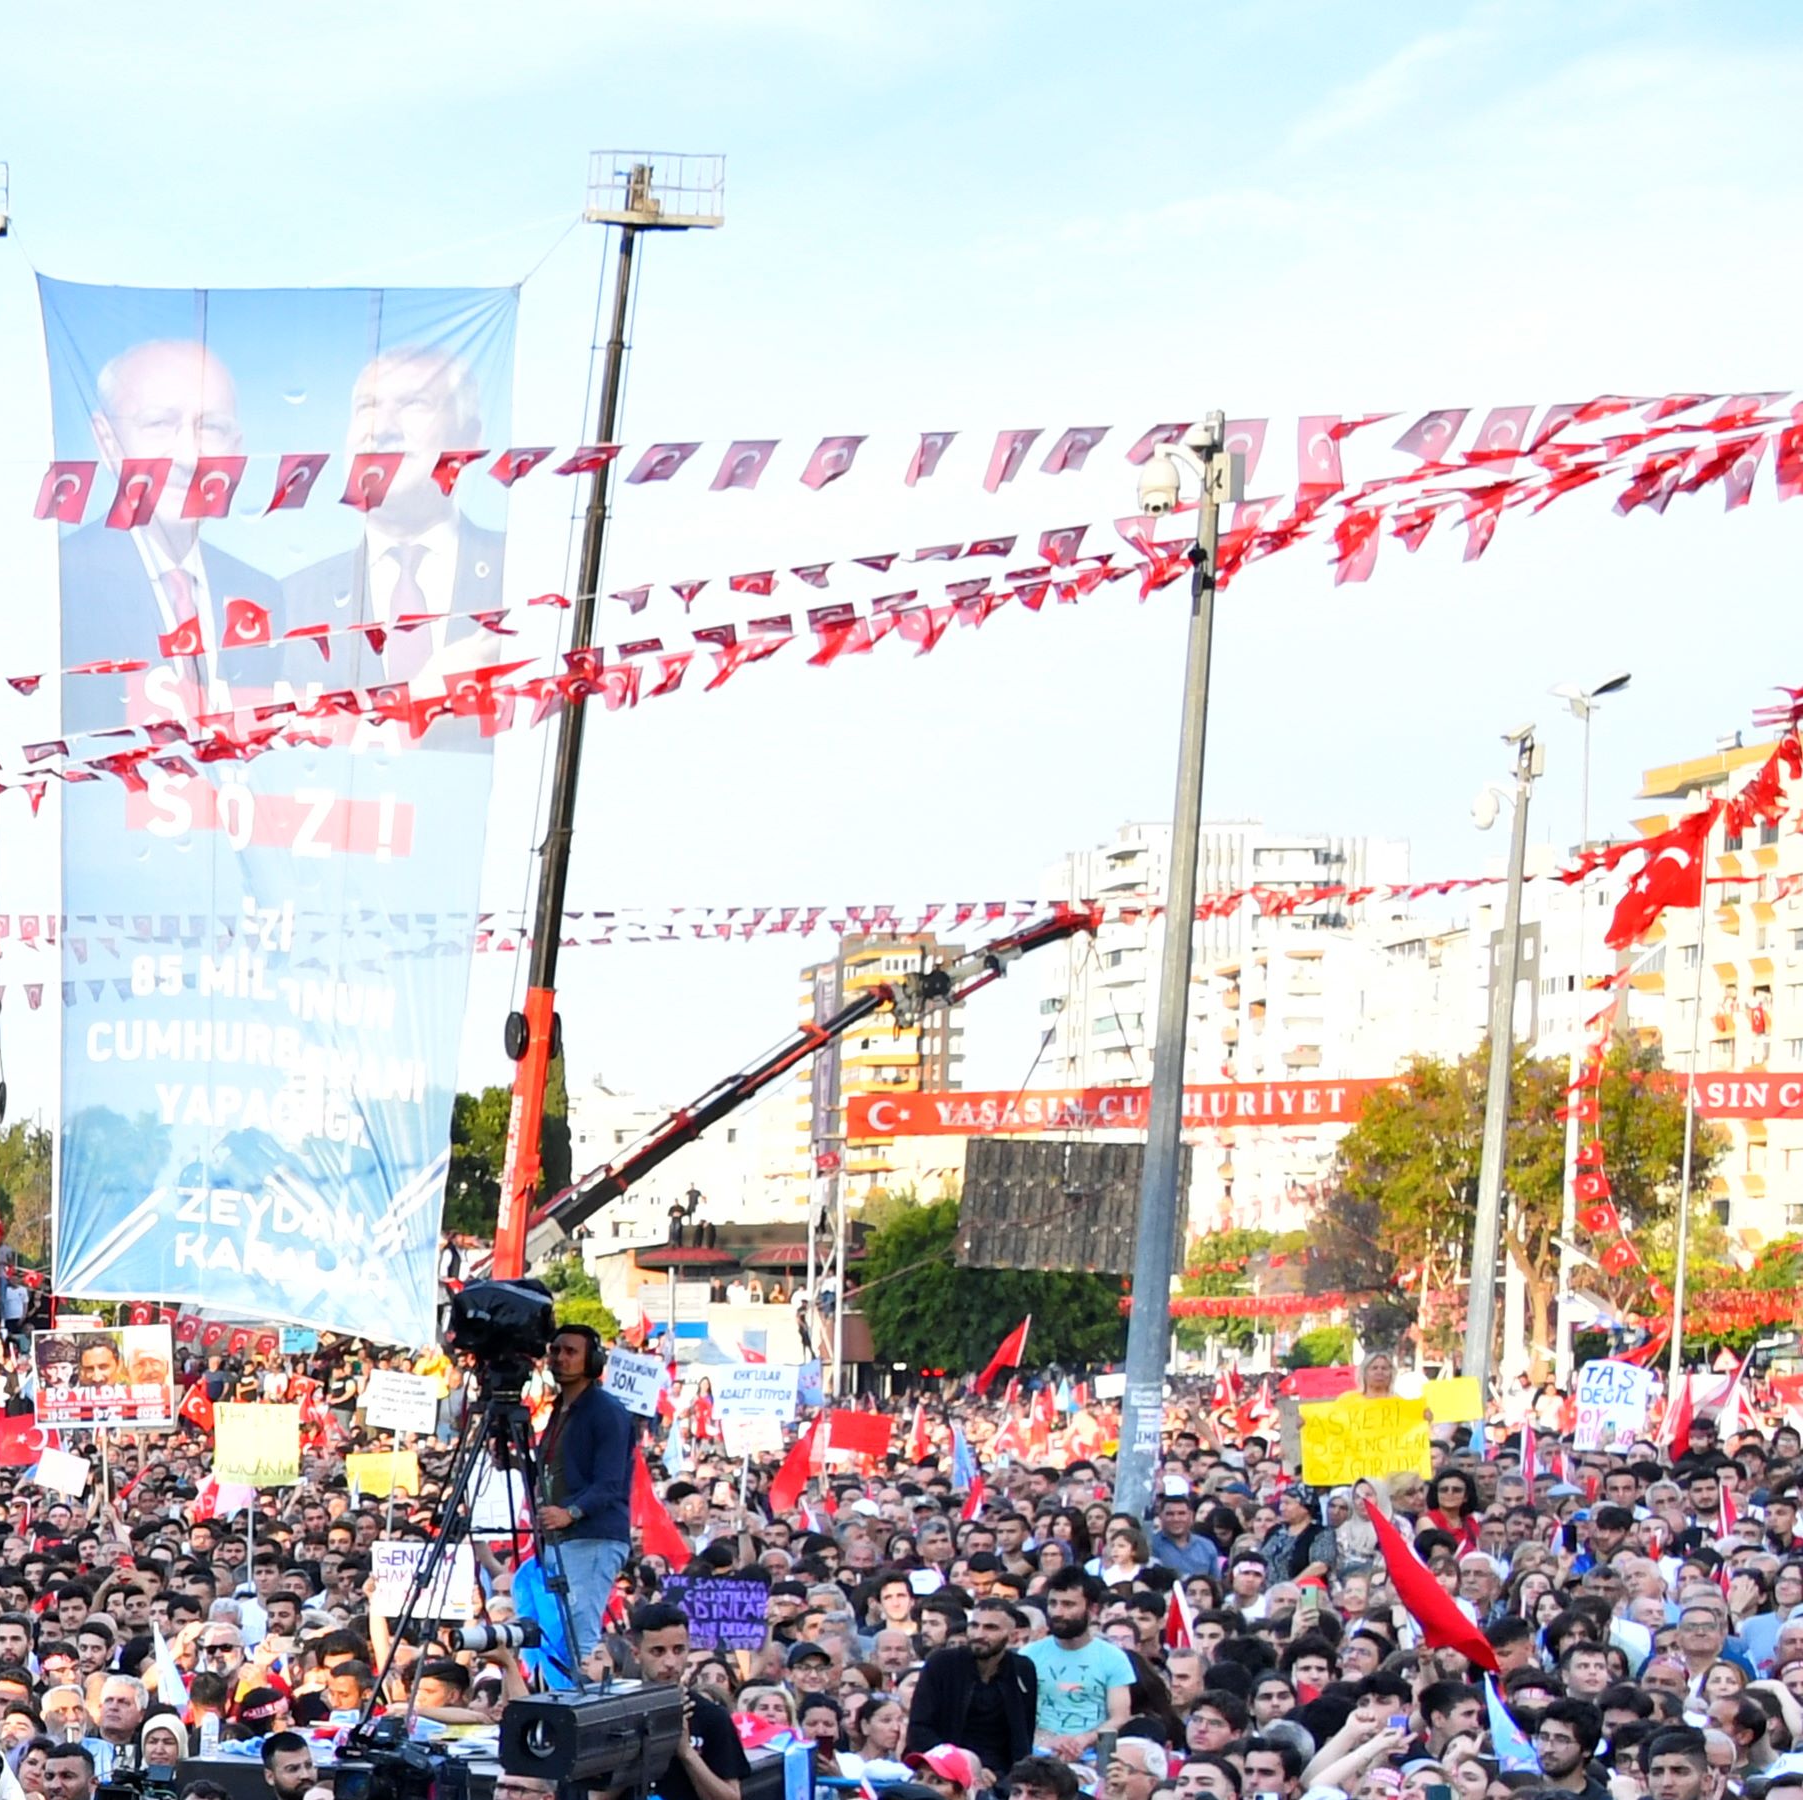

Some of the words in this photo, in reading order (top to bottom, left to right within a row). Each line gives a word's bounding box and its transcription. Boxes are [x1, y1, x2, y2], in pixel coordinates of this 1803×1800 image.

[145, 665, 414, 751] SANA
[146, 767, 396, 863] SÖZ!
[131, 953, 183, 997] 85
[199, 948, 396, 1030] MİLNUN
[86, 1018, 426, 1106] CUMHURBKANI
[936, 1096, 1083, 1131] YAŞASIN
[1099, 1084, 1346, 1123] CUHURİYET
[1683, 1082, 1769, 1108] ASIN
[174, 1187, 365, 1246] ZEYDAN
[45, 1387, 70, 1402] 50
[72, 1385, 127, 1402] YILDA
[1309, 1401, 1401, 1437] ASKERİ
[1580, 1408, 1610, 1427] OY
